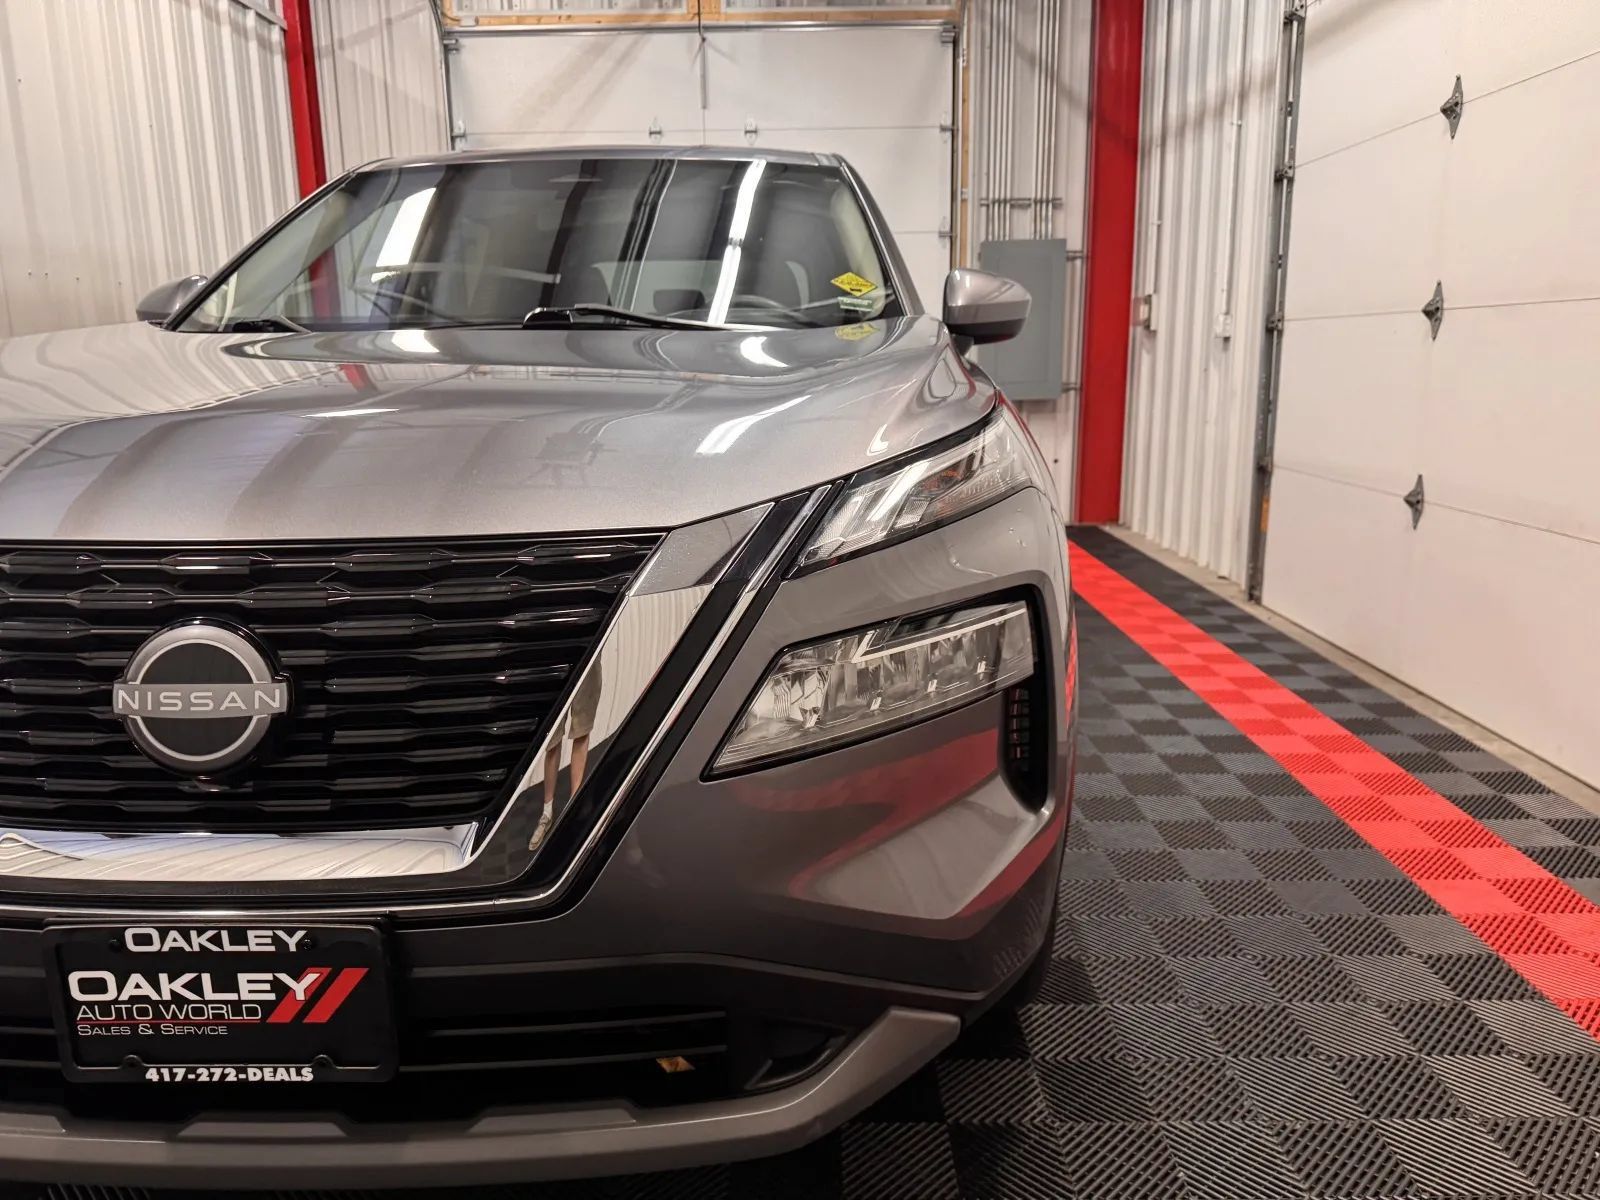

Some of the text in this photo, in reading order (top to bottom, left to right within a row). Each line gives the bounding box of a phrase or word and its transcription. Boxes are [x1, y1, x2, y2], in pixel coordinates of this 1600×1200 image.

[118, 689, 280, 711] NISSAN
[124, 927, 308, 952] OAKLEY
[67, 970, 321, 1001] OAKLEY
[76, 1004, 262, 1021] AUTO WORLD
[77, 1023, 228, 1036] SALES & SERVICE
[145, 1067, 314, 1082] 417-272-DEALS
